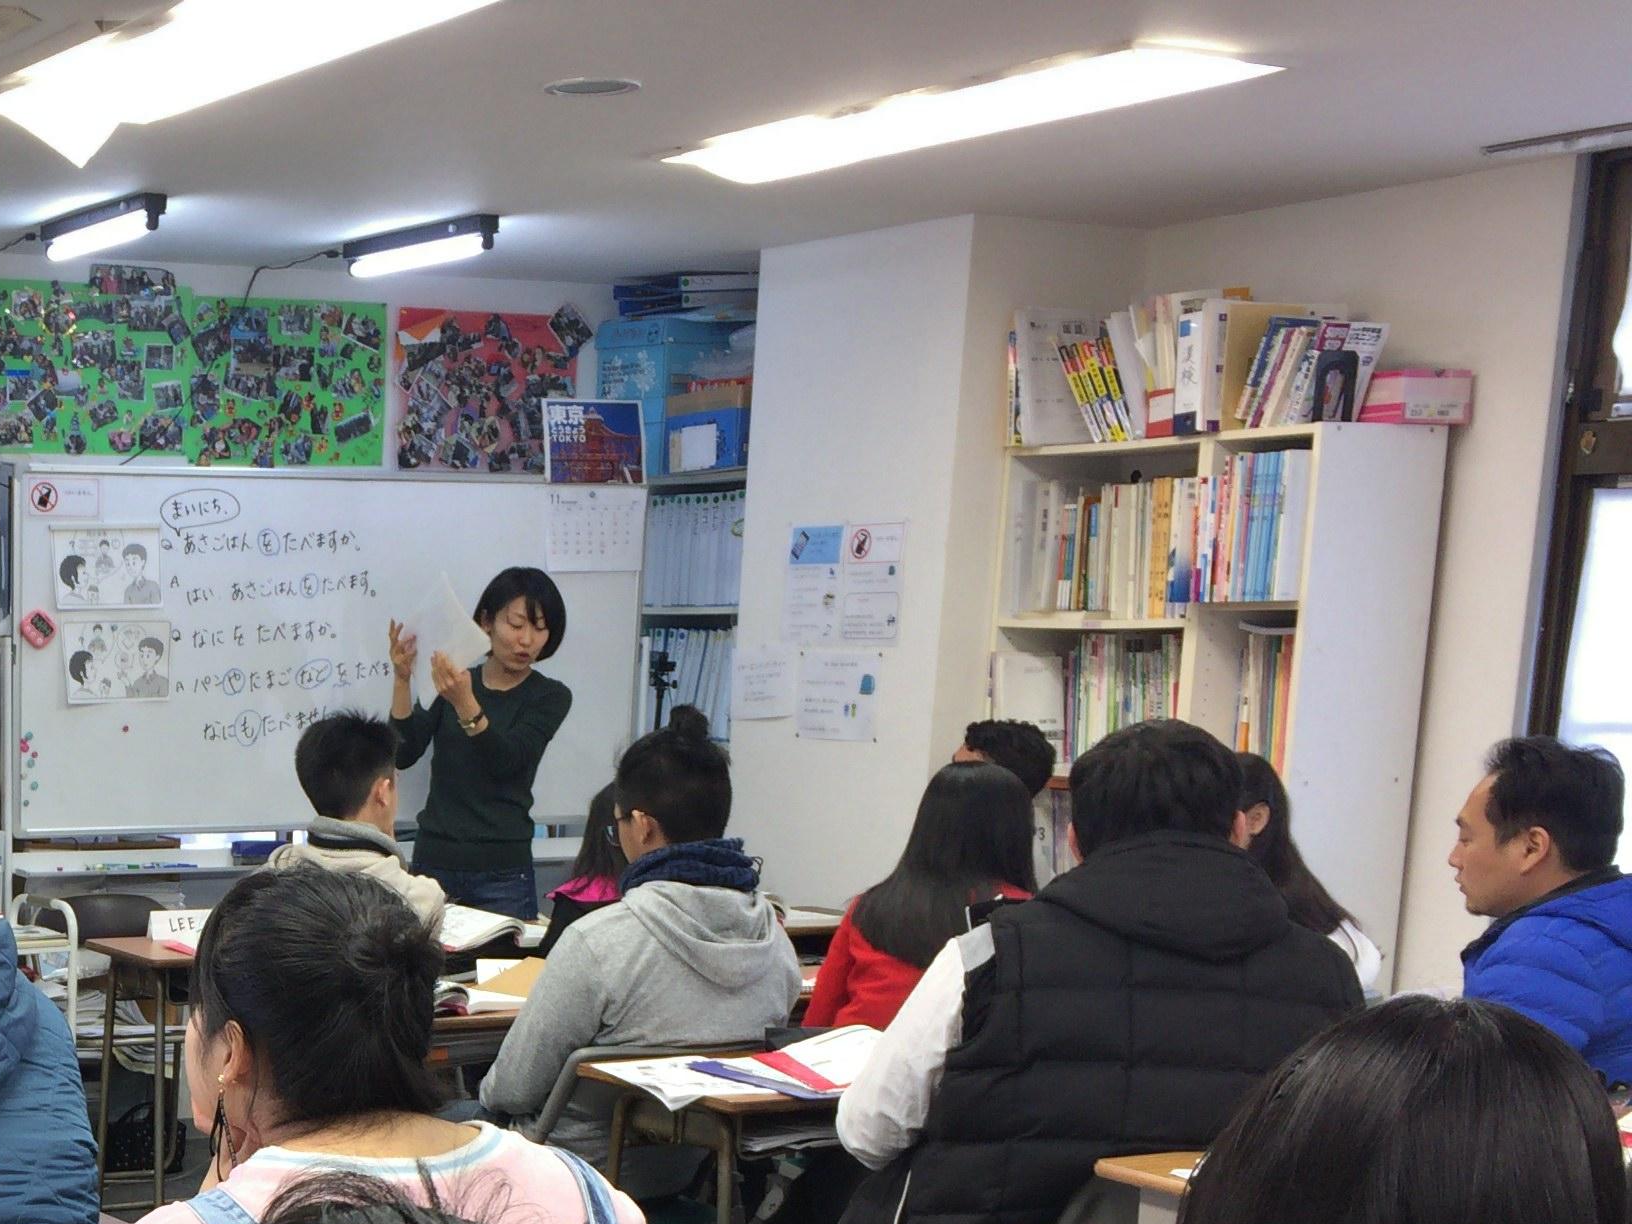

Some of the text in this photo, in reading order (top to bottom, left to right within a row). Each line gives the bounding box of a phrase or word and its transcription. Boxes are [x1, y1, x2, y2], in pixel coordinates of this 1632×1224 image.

[548, 404, 585, 425] 東京
[551, 434, 587, 443] TOKYO
[169, 575, 180, 588] A
[168, 916, 196, 933] LEE
